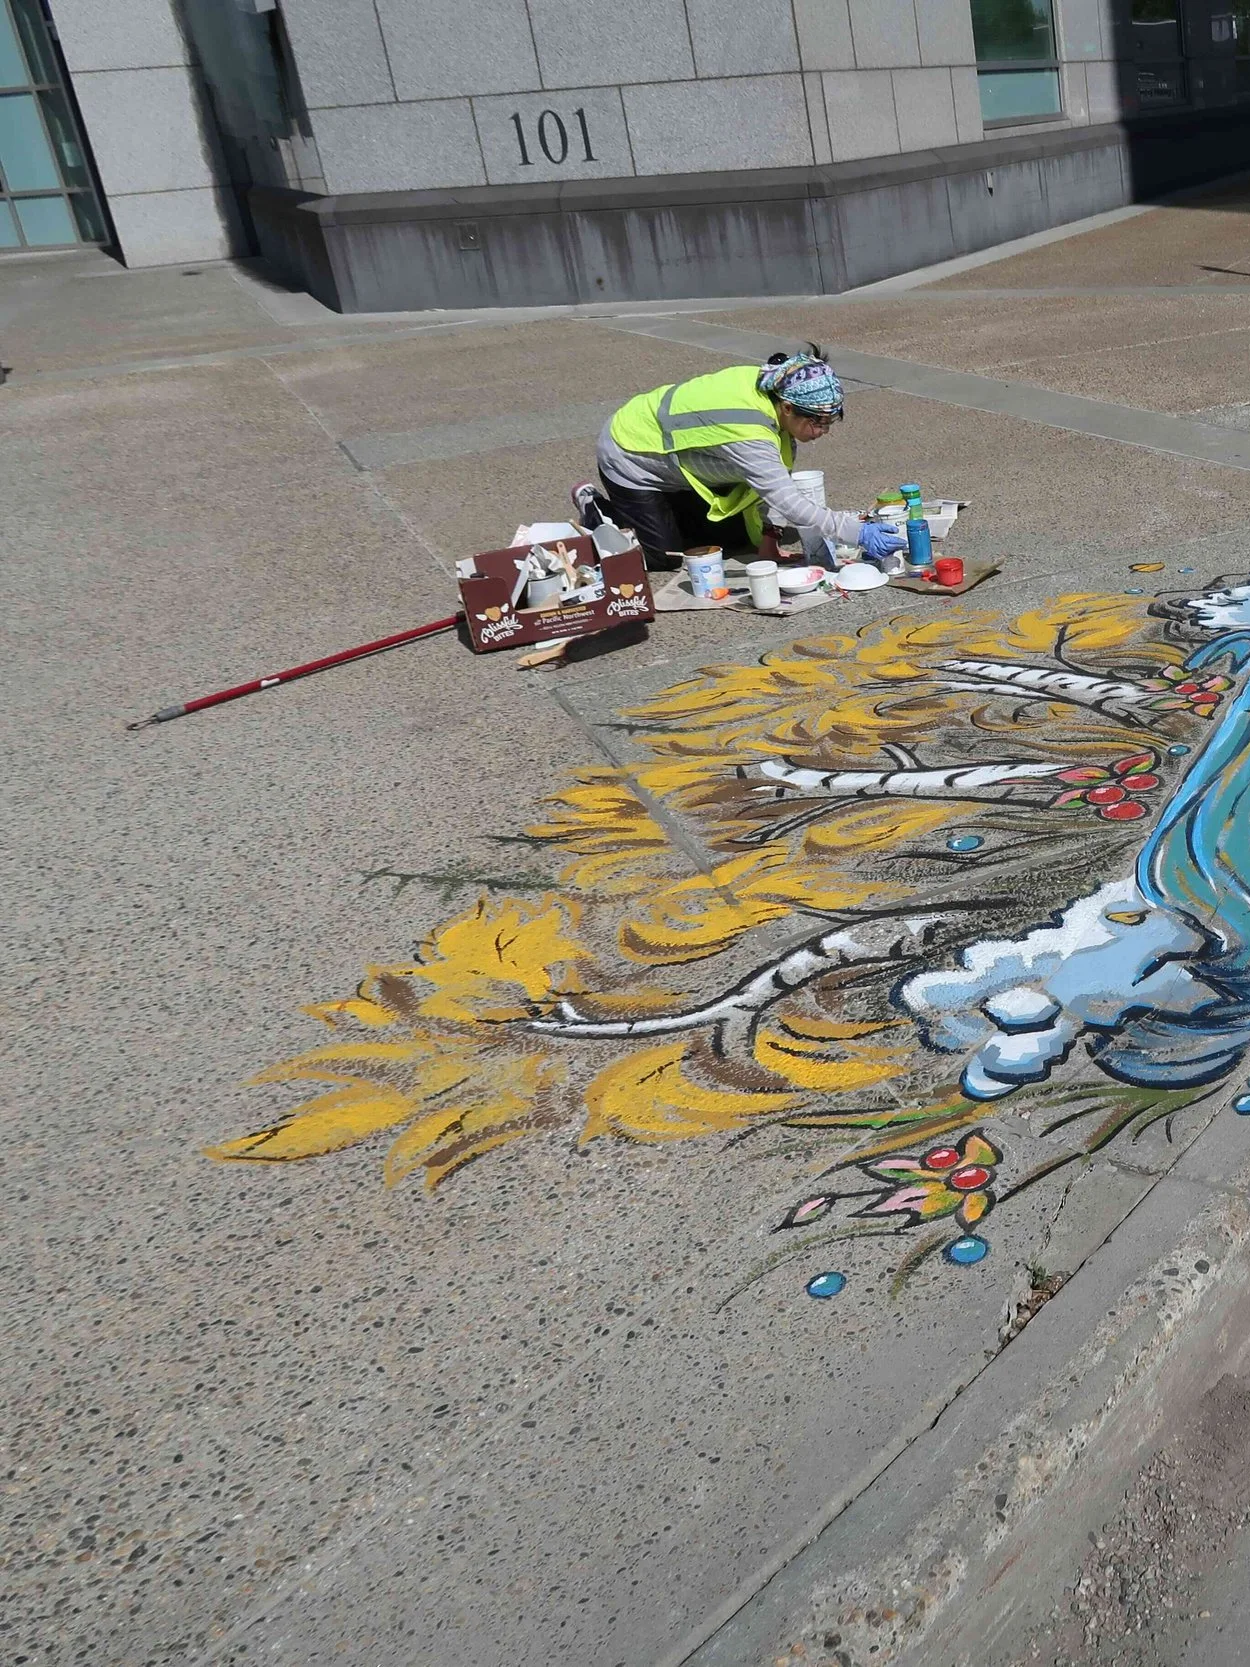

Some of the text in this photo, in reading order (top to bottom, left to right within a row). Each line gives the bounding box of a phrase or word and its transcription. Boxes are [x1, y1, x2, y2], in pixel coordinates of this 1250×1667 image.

[509, 108, 599, 166] 101
[606, 595, 650, 616] Blissful
[618, 609, 640, 617] BITES
[480, 613, 524, 644] Blissful
[493, 629, 515, 642] BITES
